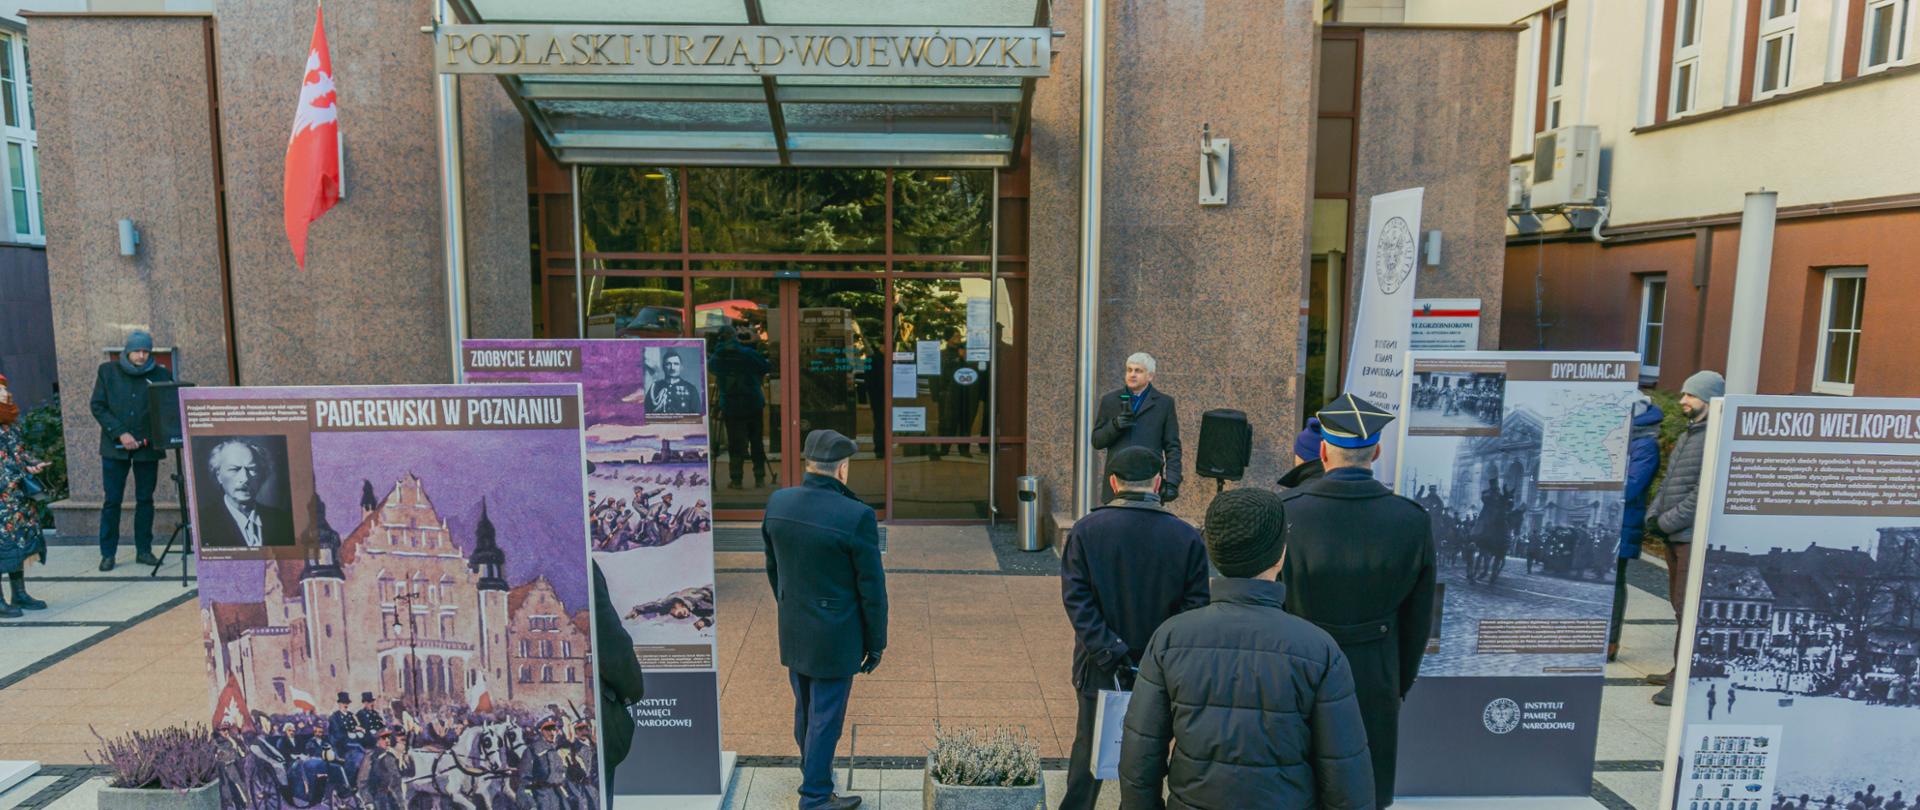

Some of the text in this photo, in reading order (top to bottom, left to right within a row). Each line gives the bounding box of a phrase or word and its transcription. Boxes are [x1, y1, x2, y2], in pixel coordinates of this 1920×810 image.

[445, 29, 1042, 72] PODLASKI URZĄD WOJEWÓDZKI
[470, 350, 573, 368] ZDOBYCIE ŁAWICY
[1551, 362, 1626, 380] DYPLOMACJA
[315, 397, 563, 428] PADEREWSKI W POZNANIU
[1741, 411, 1815, 437] WOJSKO
[636, 708, 671, 718] PAMIĘCI
[1524, 702, 1565, 710] INSTYTUT
[637, 719, 692, 728] NARODOWEJ
[1523, 712, 1557, 721] PAMIĘCI
[1522, 722, 1576, 731] NARODOWEJ
